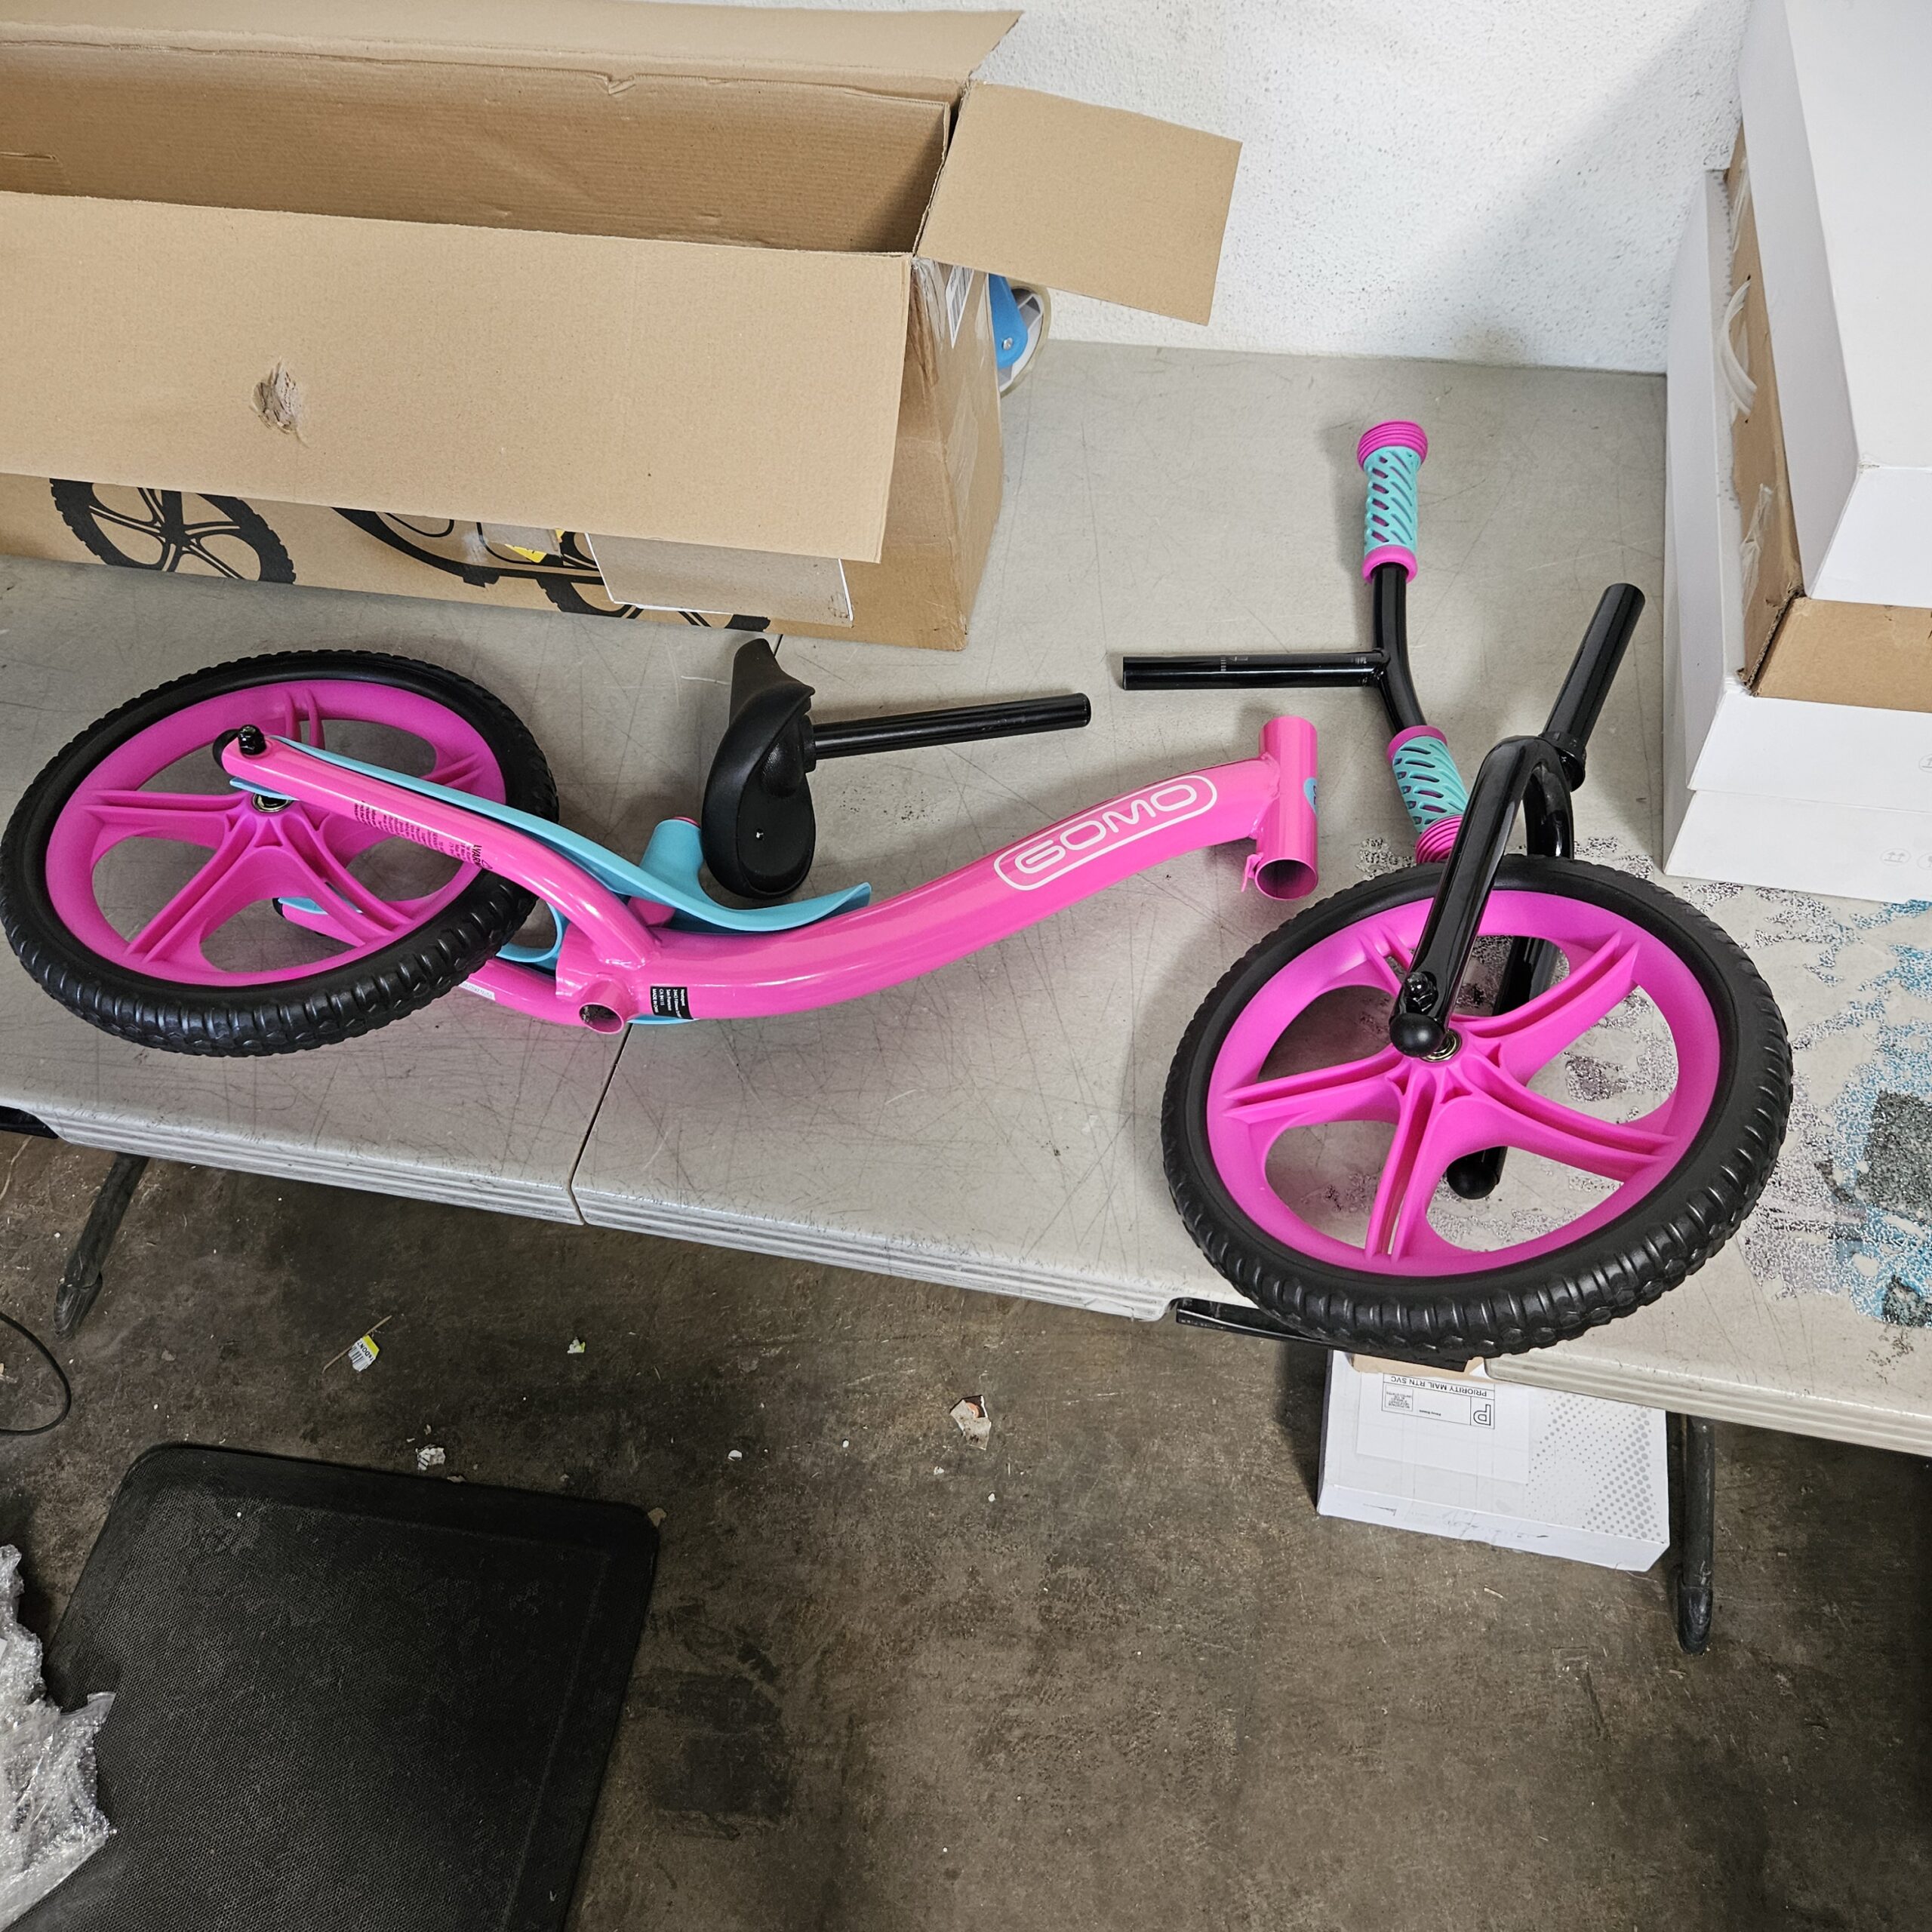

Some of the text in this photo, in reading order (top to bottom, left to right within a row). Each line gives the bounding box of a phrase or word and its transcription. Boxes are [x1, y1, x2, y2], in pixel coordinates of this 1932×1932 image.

[1014, 784, 1198, 875] GOMO
[1390, 1376, 1487, 1397] PRIORITY MAIL RTN SVC
[1473, 1404, 1491, 1426] P
